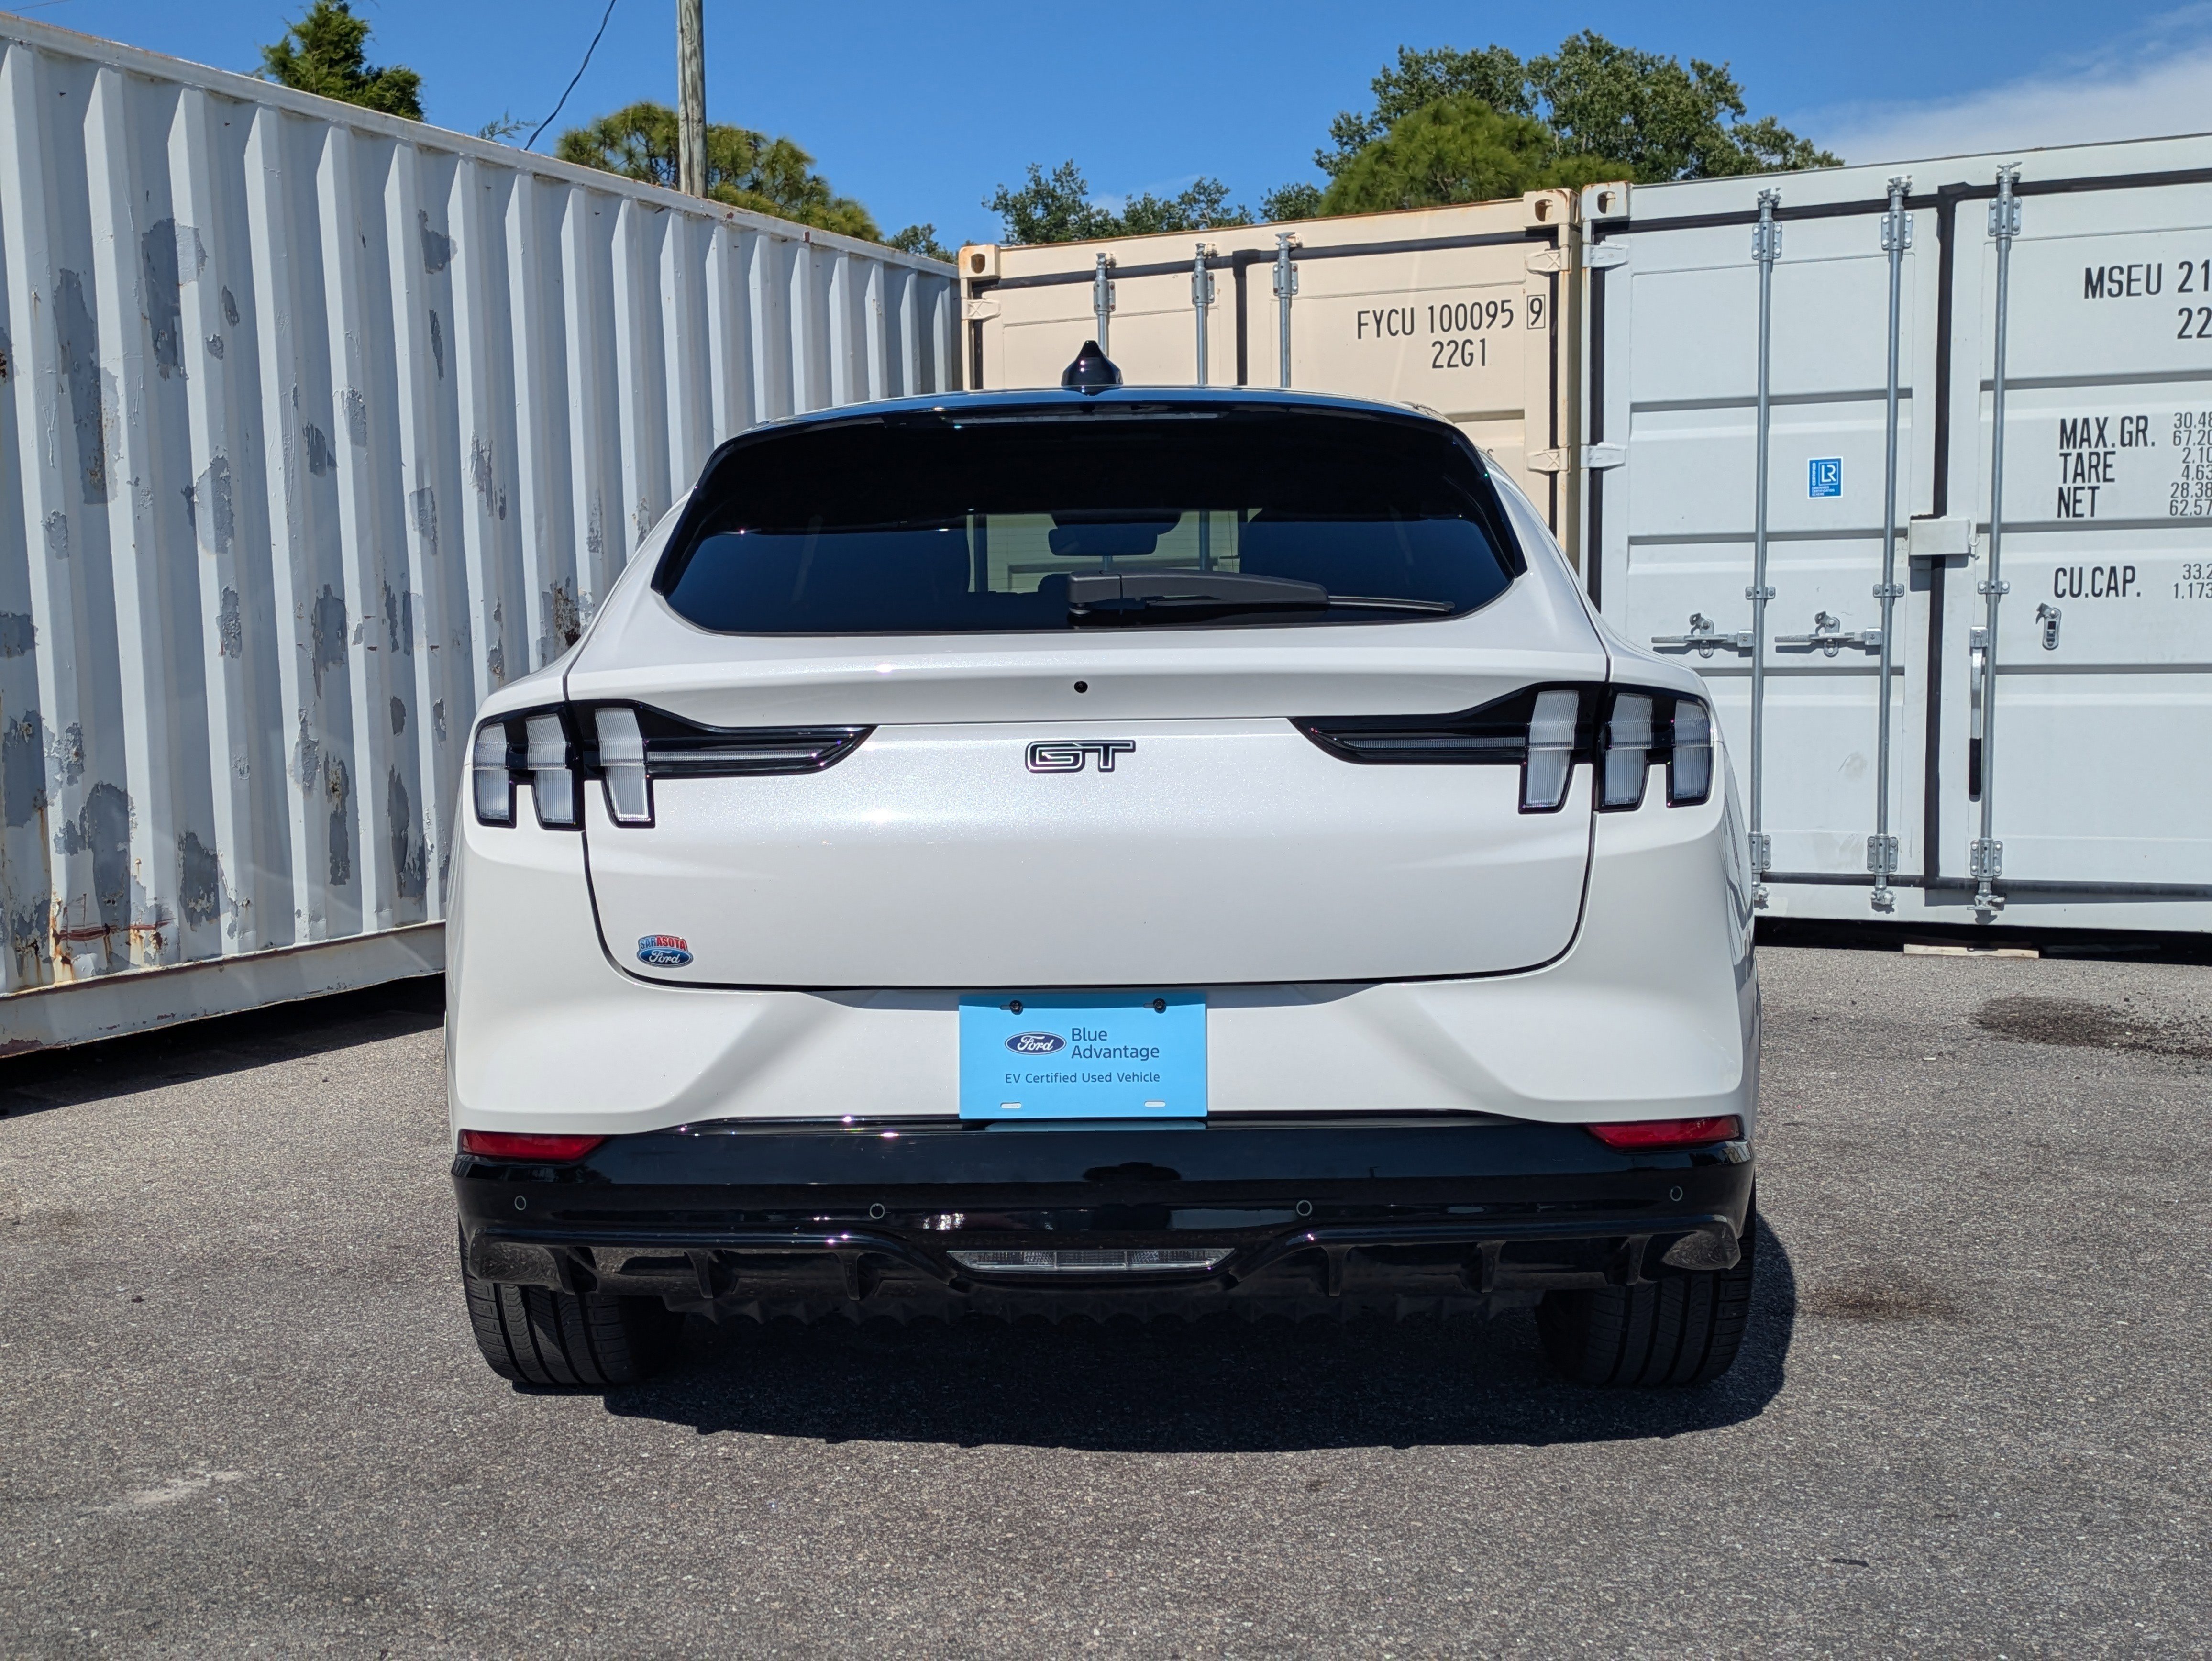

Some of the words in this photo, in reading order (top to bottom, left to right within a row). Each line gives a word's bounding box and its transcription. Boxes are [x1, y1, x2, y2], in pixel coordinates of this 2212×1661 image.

[2084, 263, 2162, 299] MSEU
[2177, 259, 2211, 293] 21
[1357, 307, 1415, 340] FYCU
[1427, 299, 1514, 334] 100095
[1530, 297, 1544, 327] 9
[2177, 306, 2212, 340] 22
[1431, 338, 1486, 369] 22G1
[2059, 415, 2156, 450] MAX.GR.
[1821, 464, 1836, 483] LR
[2059, 451, 2116, 484] TARE
[2057, 486, 2100, 518] NET
[2054, 565, 2141, 598] CU.CAP.
[1025, 739, 1136, 774] GT
[639, 936, 686, 951] SARASOTA
[649, 949, 681, 963] Ford
[1017, 1035, 1054, 1051] Ford
[1072, 1027, 1108, 1042] Blue
[1071, 1044, 1160, 1062] Advantage
[1005, 1073, 1021, 1084] EV
[1025, 1072, 1077, 1083] Certified
[1082, 1072, 1112, 1083] Used
[1117, 1071, 1161, 1083] Vehicle
